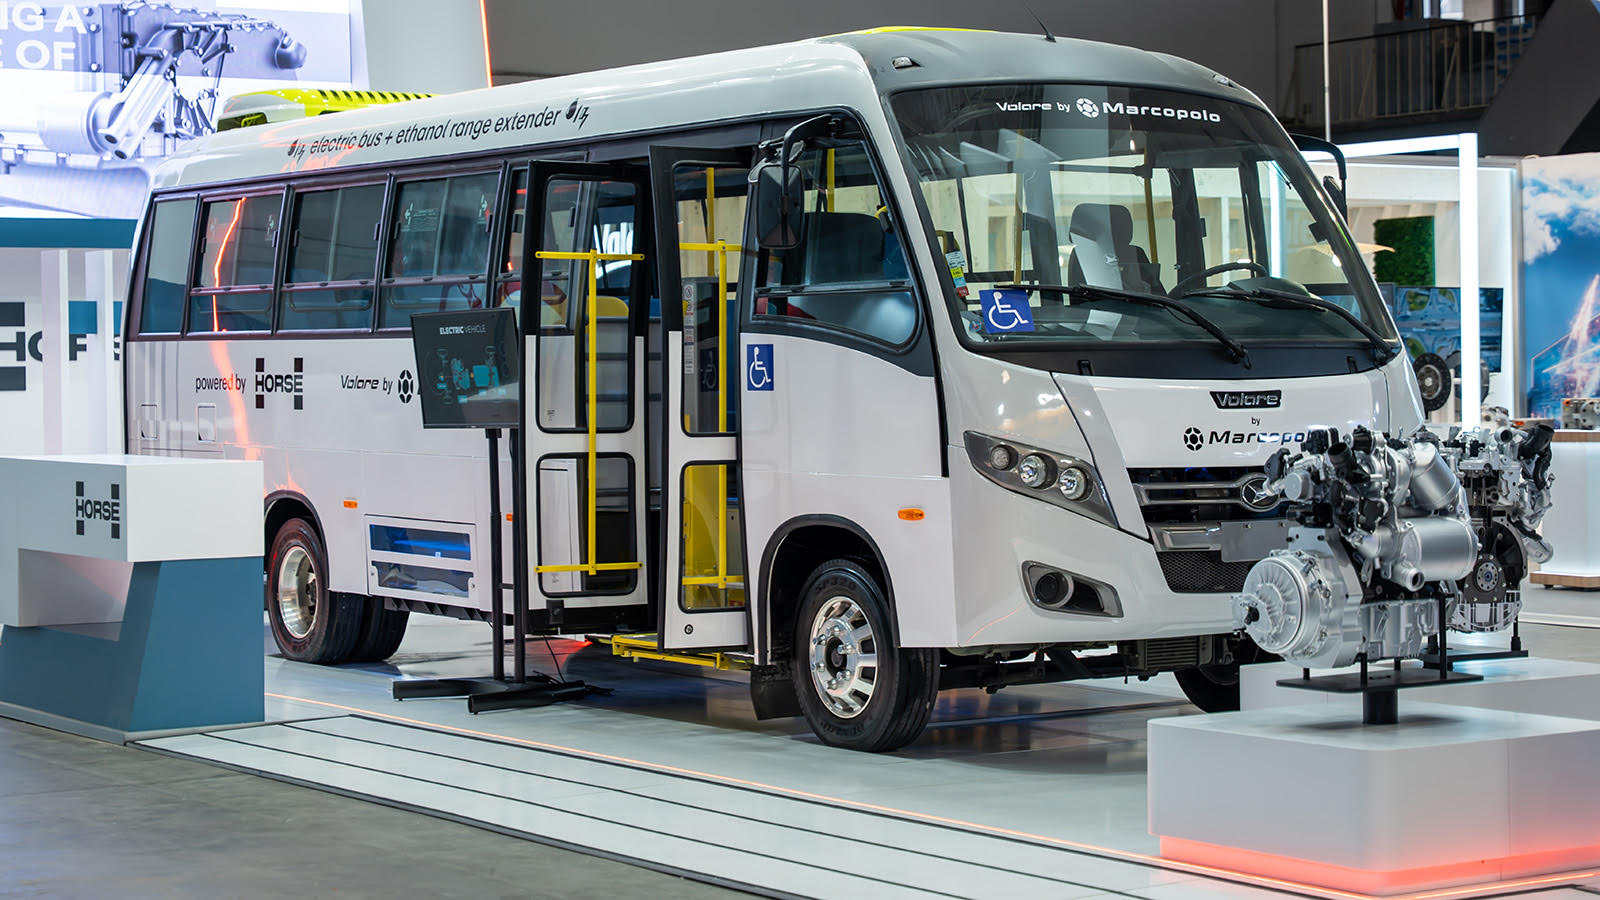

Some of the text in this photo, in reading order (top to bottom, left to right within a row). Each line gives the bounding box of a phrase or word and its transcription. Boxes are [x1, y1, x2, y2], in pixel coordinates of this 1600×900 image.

[54, 4, 88, 34] A
[15, 40, 76, 70] OF
[995, 101, 1221, 123] Volare by Marcopolo
[310, 106, 562, 155] electric bus + ethanol range extender
[439, 326, 464, 335] ELECTRIC
[195, 373, 303, 394] powered by HORSE
[340, 375, 393, 395] Volare by
[1216, 392, 1279, 407] Volare
[1251, 416, 1261, 426] by
[75, 498, 120, 521] HORSE
